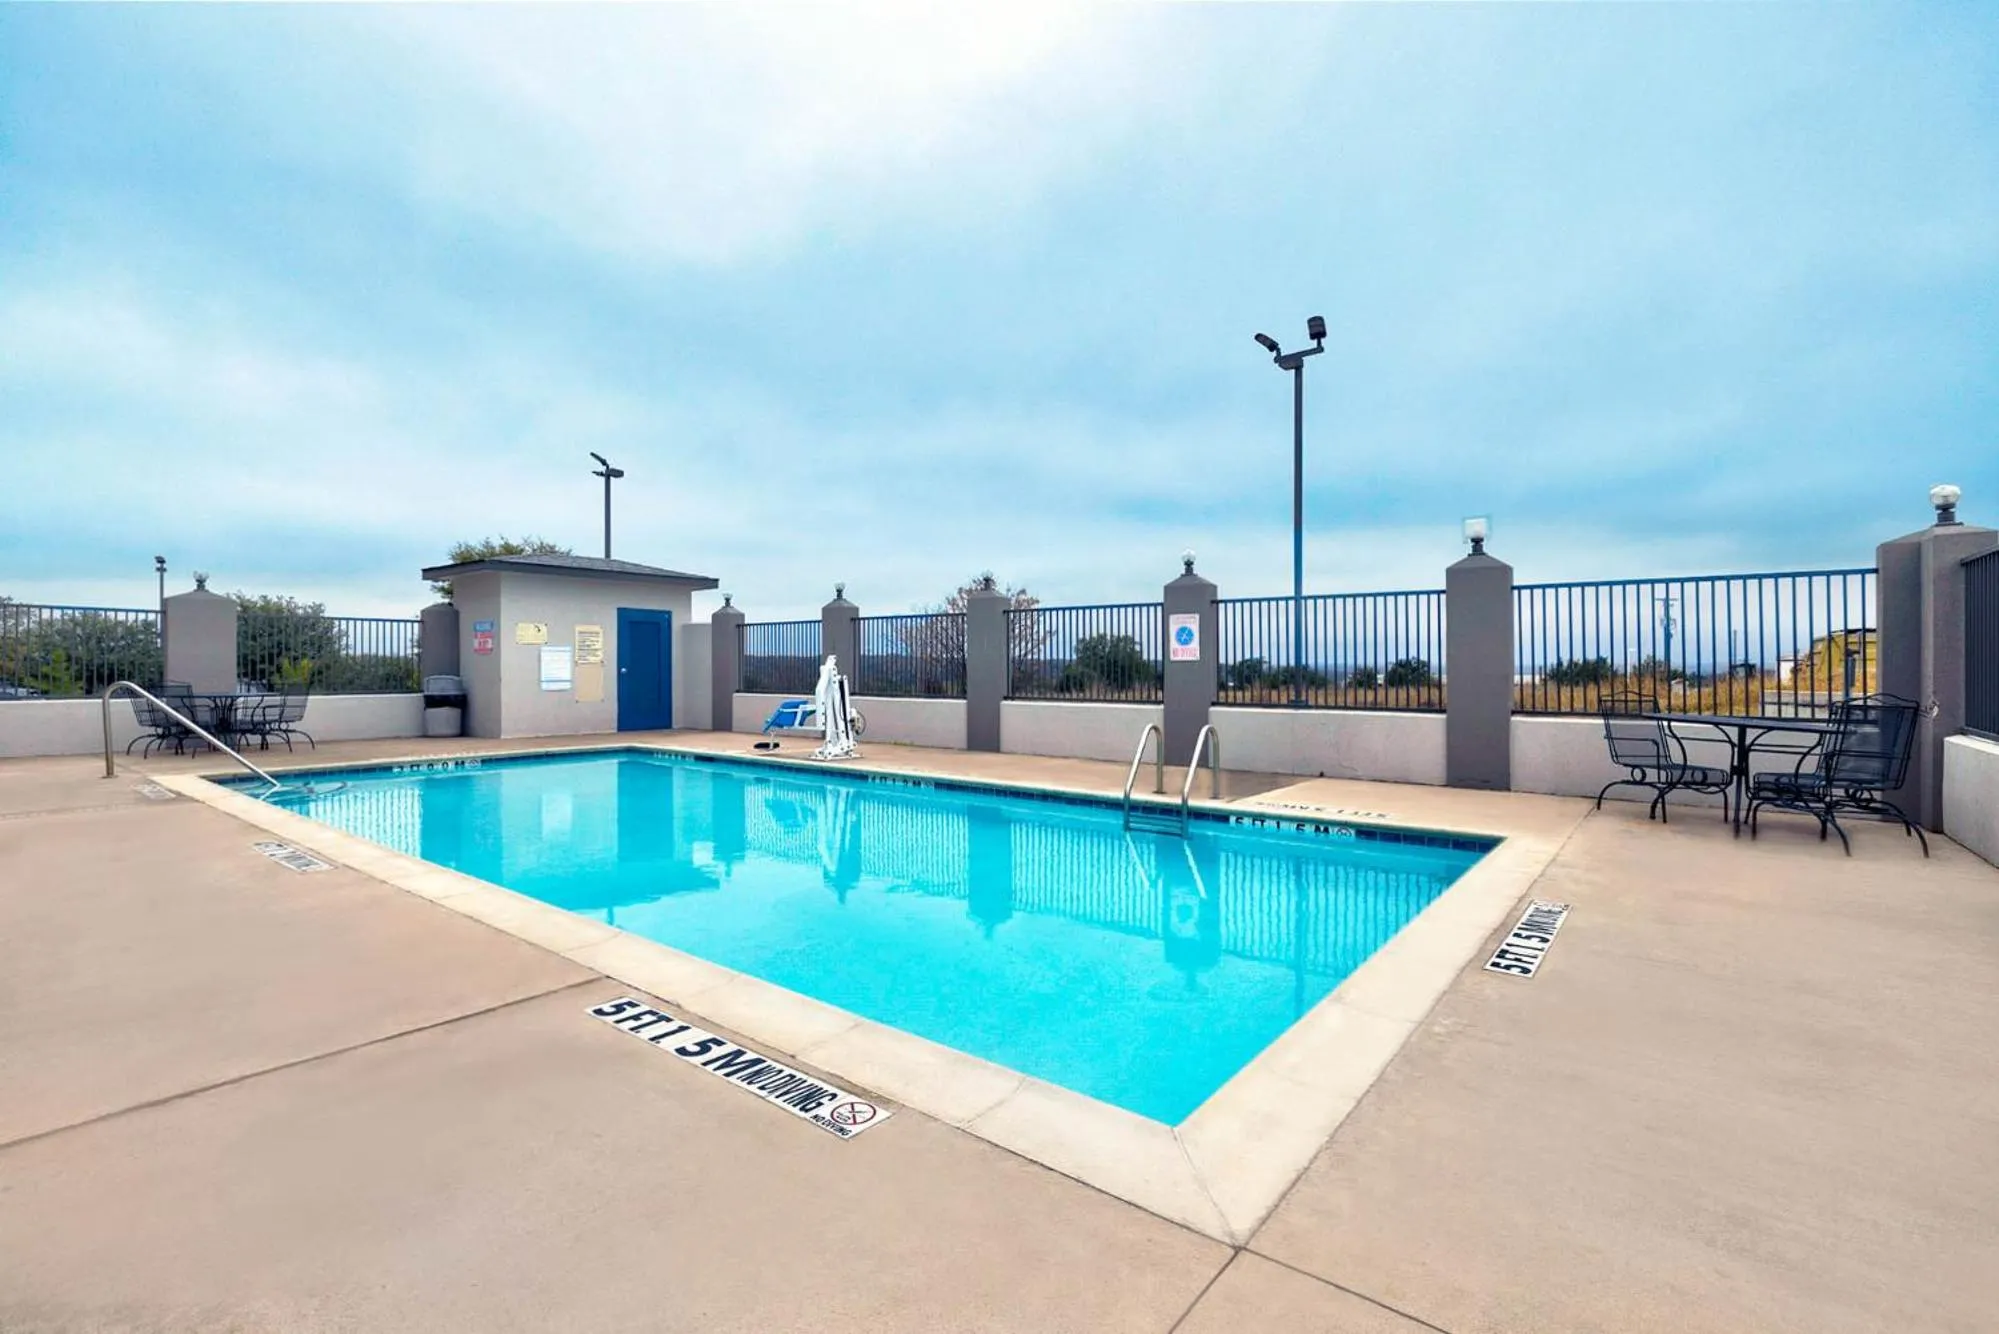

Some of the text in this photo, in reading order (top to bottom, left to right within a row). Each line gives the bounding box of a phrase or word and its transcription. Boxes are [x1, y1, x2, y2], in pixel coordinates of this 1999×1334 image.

[1490, 962, 1532, 974] 5
[592, 1000, 641, 1017] 5
[700, 1048, 768, 1077] M
[736, 1064, 784, 1086] NO
[757, 1074, 838, 1113] DIVING
